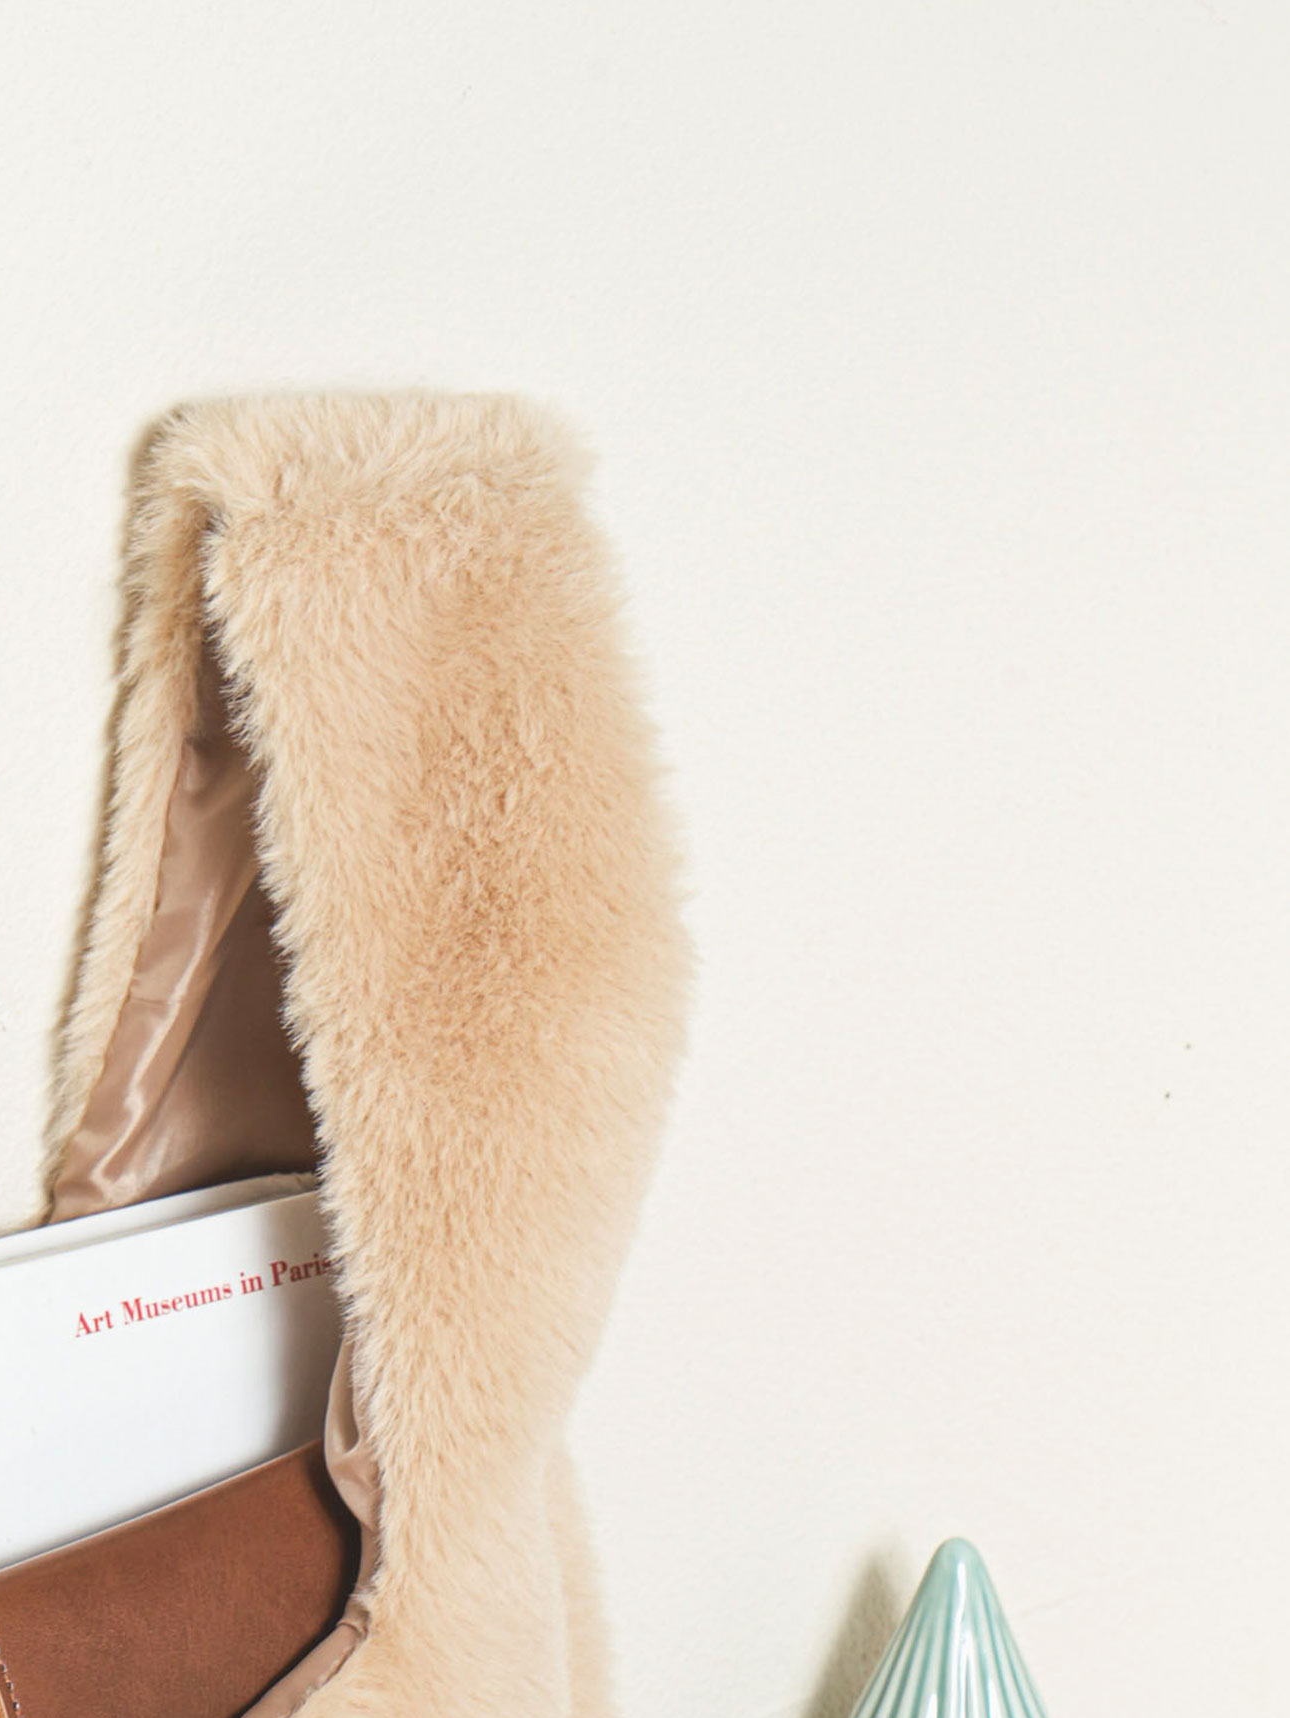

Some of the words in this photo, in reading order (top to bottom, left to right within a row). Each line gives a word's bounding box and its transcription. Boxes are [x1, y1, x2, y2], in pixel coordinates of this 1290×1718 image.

[74, 1310, 114, 1338] Art
[121, 1281, 233, 1325] Museums
[240, 1272, 264, 1295] in
[269, 1253, 332, 1287] Paris
